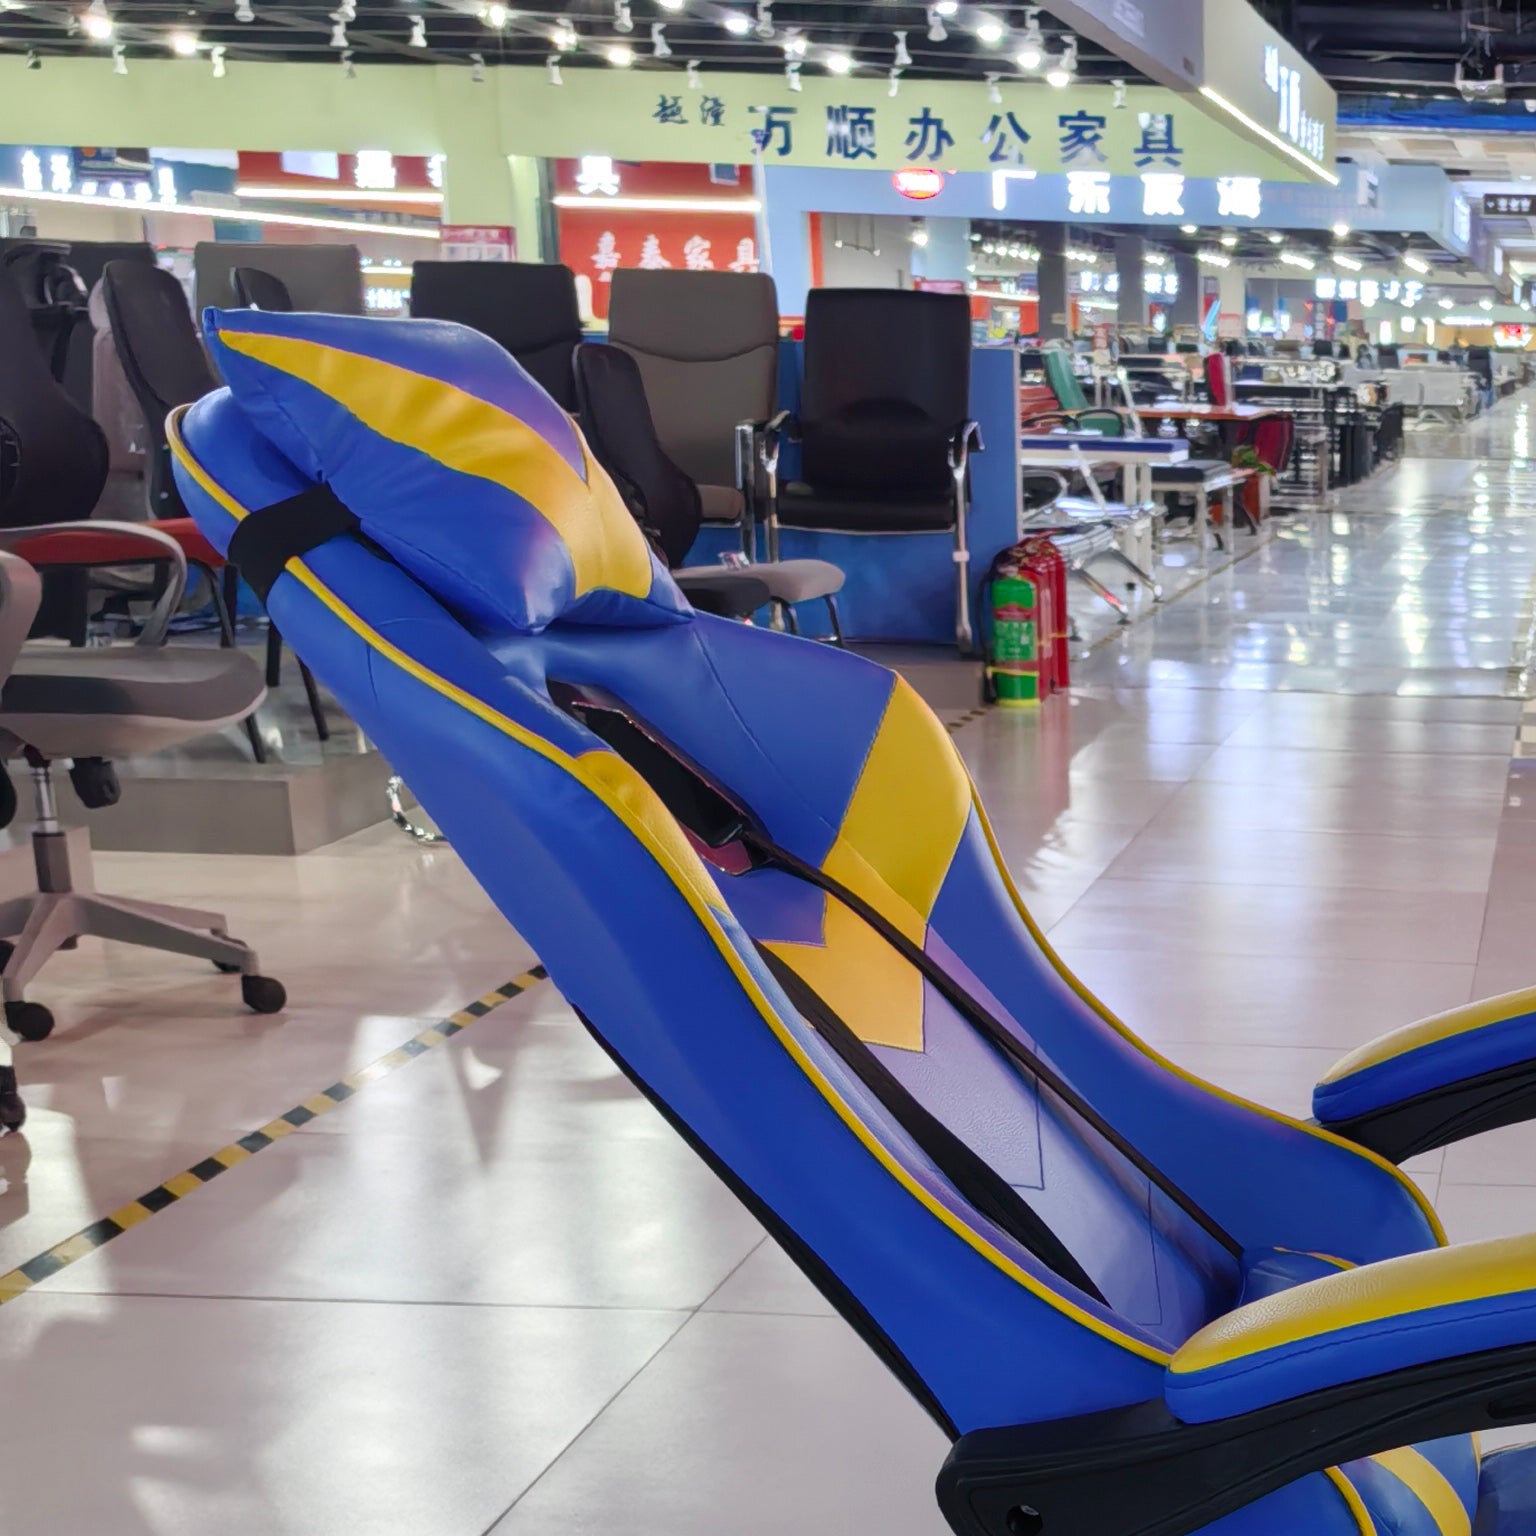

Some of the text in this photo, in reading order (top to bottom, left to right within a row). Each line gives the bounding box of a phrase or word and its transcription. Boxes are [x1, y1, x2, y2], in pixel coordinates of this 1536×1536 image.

[748, 104, 1183, 167] 万顺办公家具
